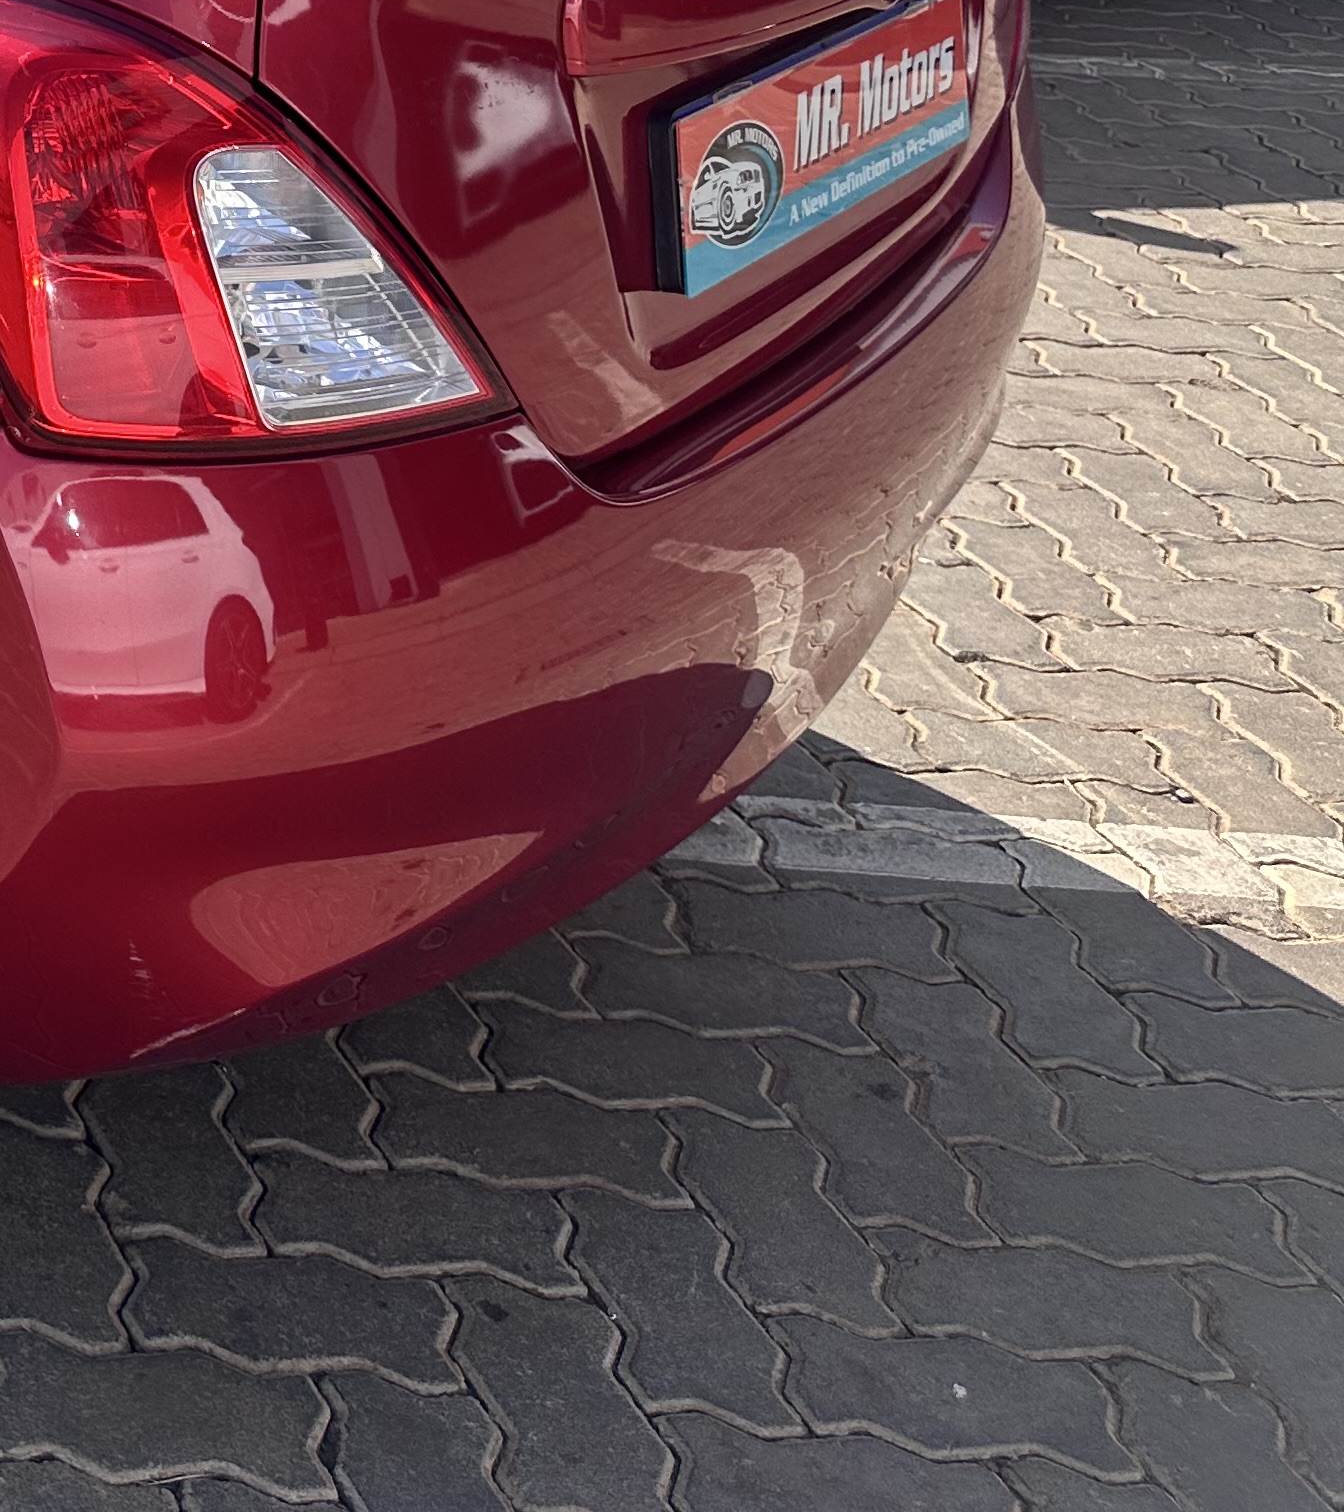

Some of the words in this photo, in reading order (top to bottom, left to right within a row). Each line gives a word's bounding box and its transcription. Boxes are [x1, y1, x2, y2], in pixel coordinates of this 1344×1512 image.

[744, 127, 778, 161] MOTORS
[794, 74, 850, 172] MR.
[857, 36, 955, 138] Motors
[789, 204, 800, 227] A
[801, 190, 829, 220] New
[830, 154, 891, 203] Definition
[891, 147, 905, 168] to
[906, 111, 965, 160] Pre-Owned
